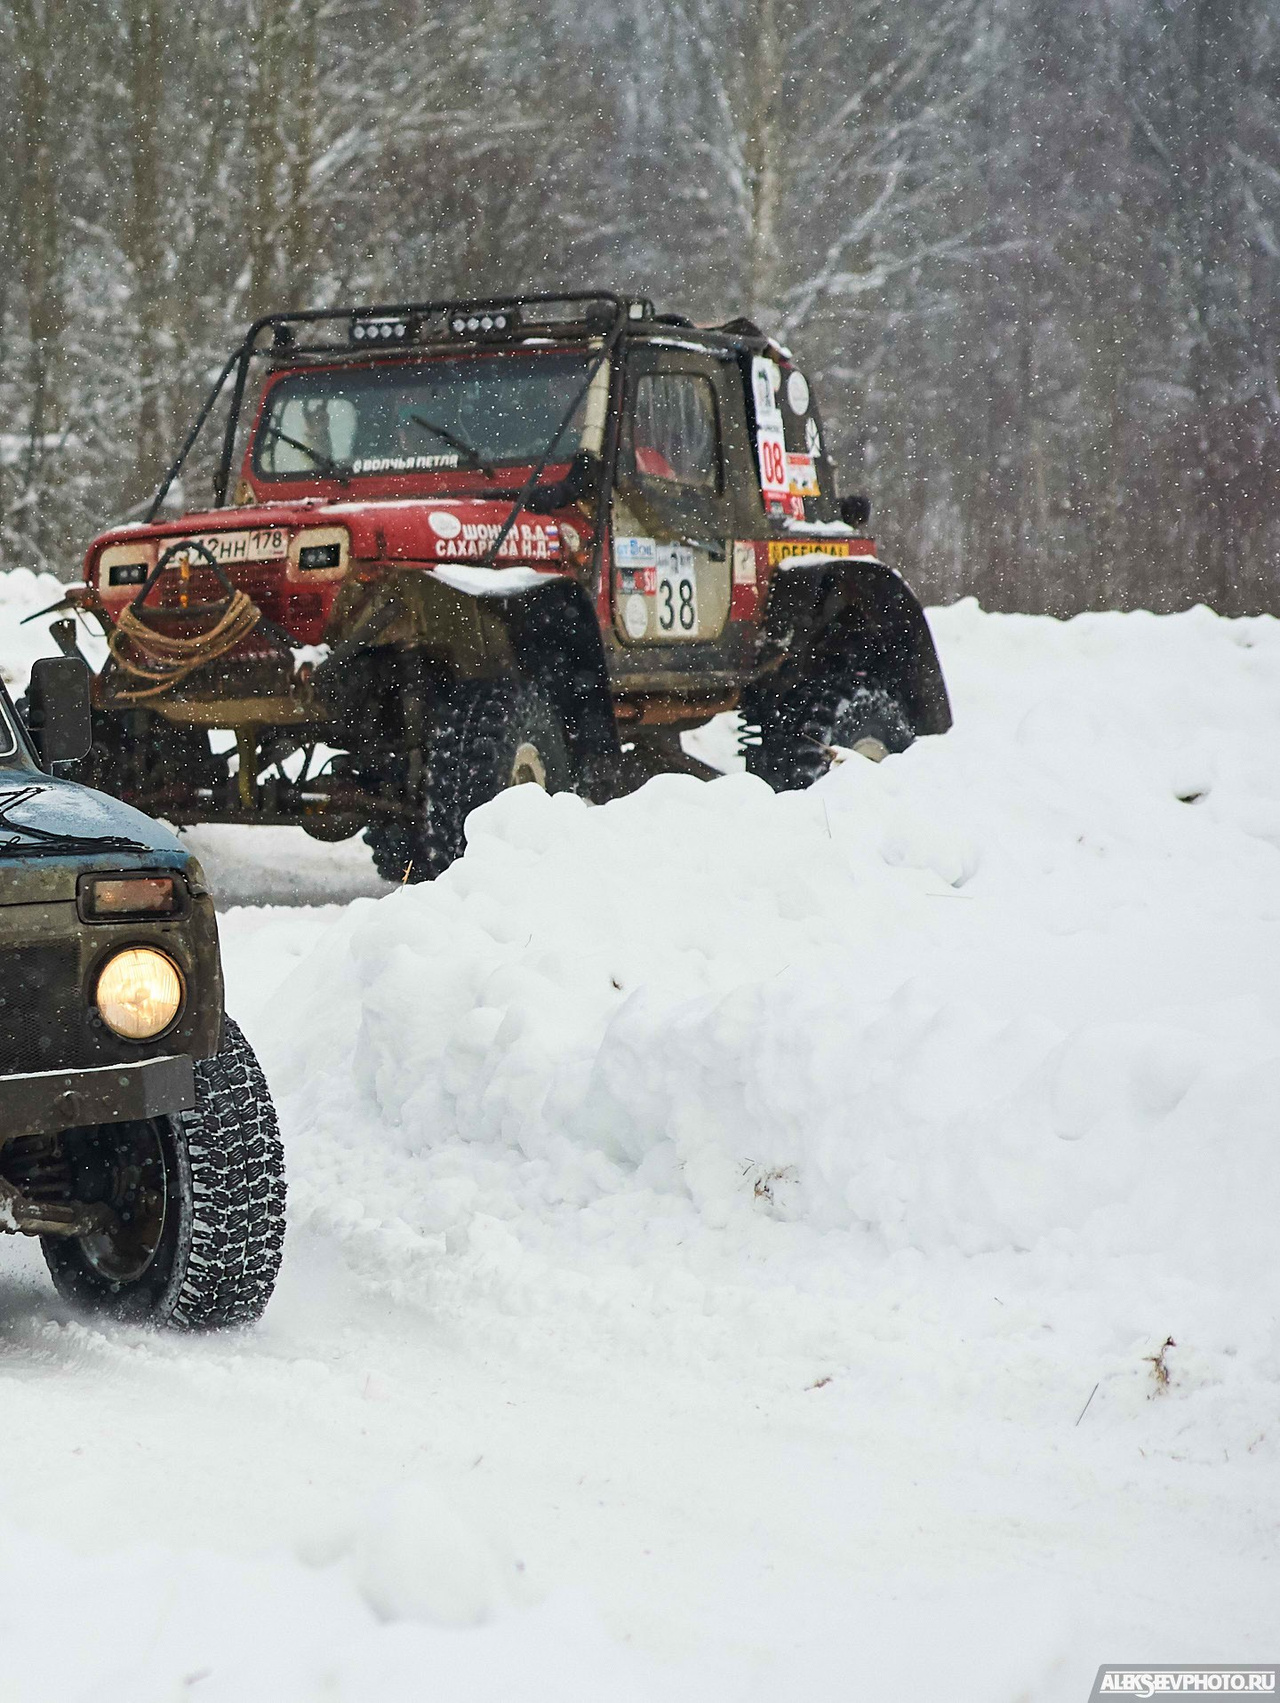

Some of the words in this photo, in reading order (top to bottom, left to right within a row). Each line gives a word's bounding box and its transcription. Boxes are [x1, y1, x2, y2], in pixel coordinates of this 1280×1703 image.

[362, 457, 415, 472] ВОЛЧЬЯ
[416, 454, 459, 469] ПЕТЛЯ
[763, 441, 785, 484] 08
[252, 530, 283, 549] 178
[659, 578, 695, 630] 38
